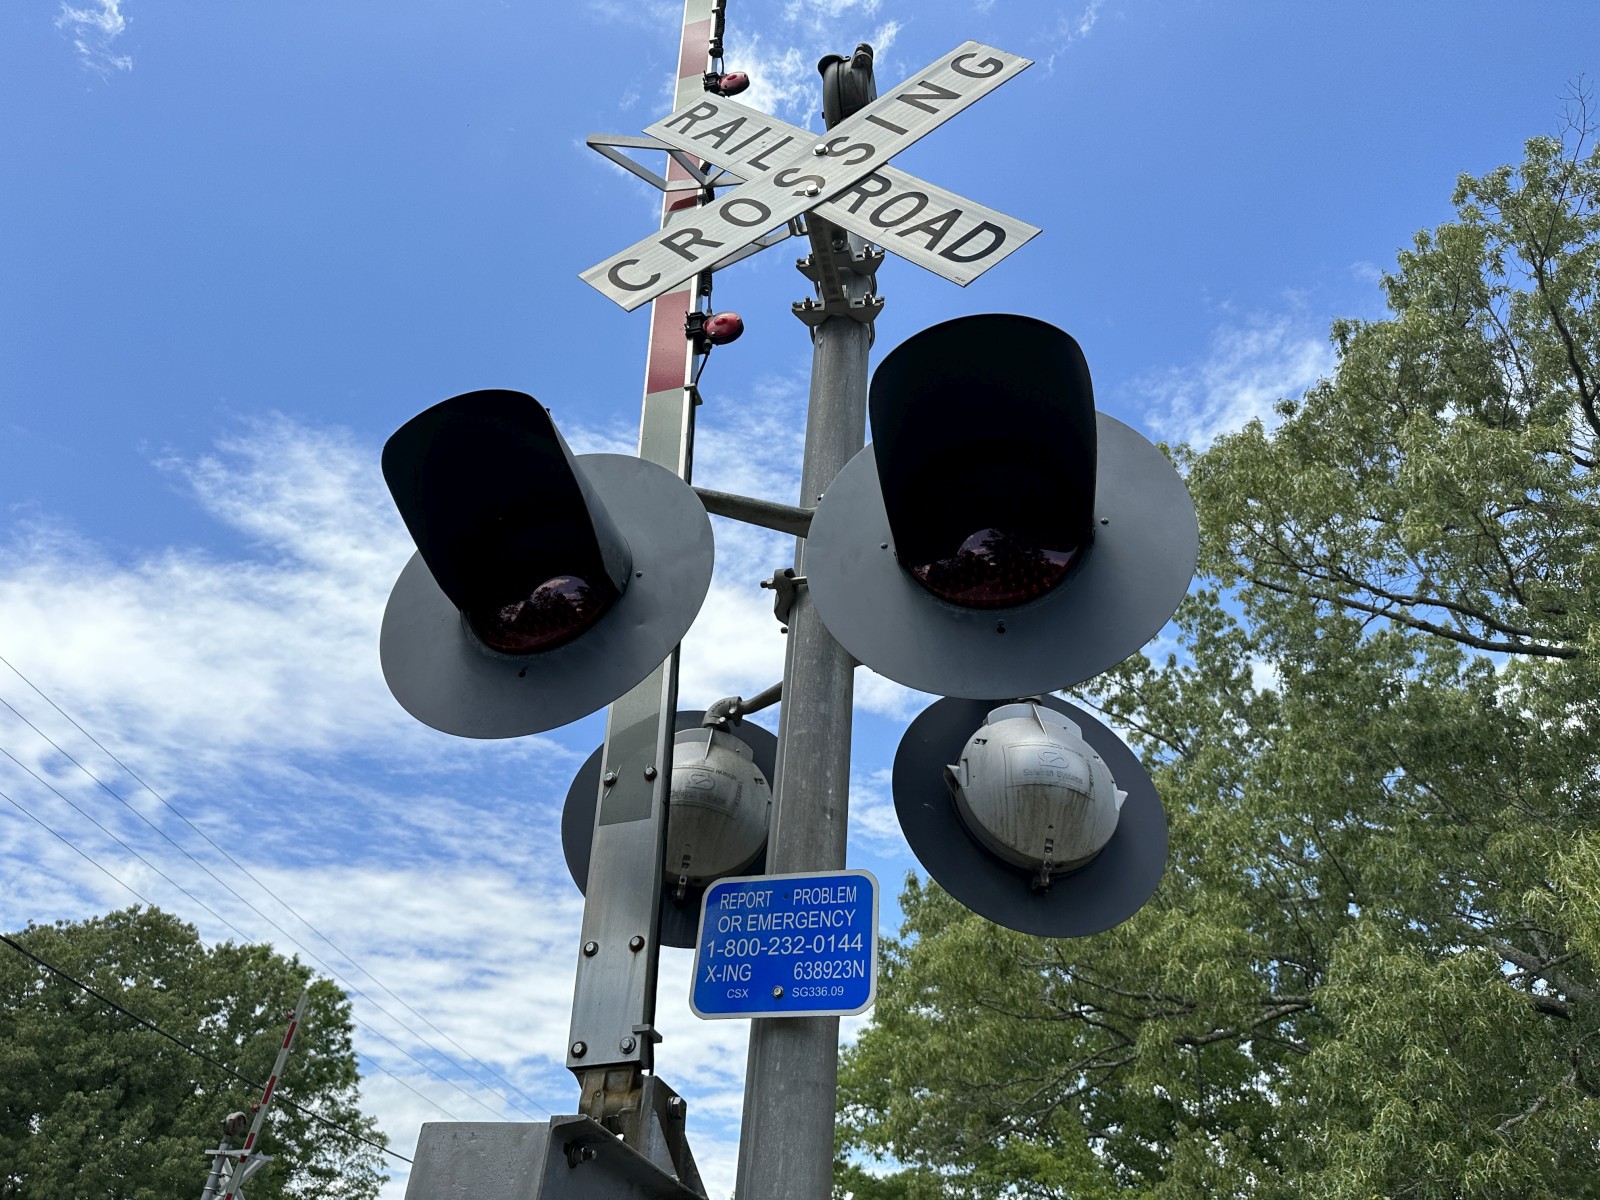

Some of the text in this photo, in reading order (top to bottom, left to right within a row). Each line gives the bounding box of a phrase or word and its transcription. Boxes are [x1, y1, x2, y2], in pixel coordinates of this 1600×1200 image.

[607, 52, 1004, 292] CROSSING
[664, 101, 1007, 264] RAIL ROAD
[720, 885, 857, 910] REPORT PROBLEM
[717, 908, 856, 933] OR EMERGENCY
[707, 933, 863, 958] 1-800-232-0144
[704, 960, 865, 983] X-ING 638923N
[726, 986, 844, 999] CSX SG336.09
